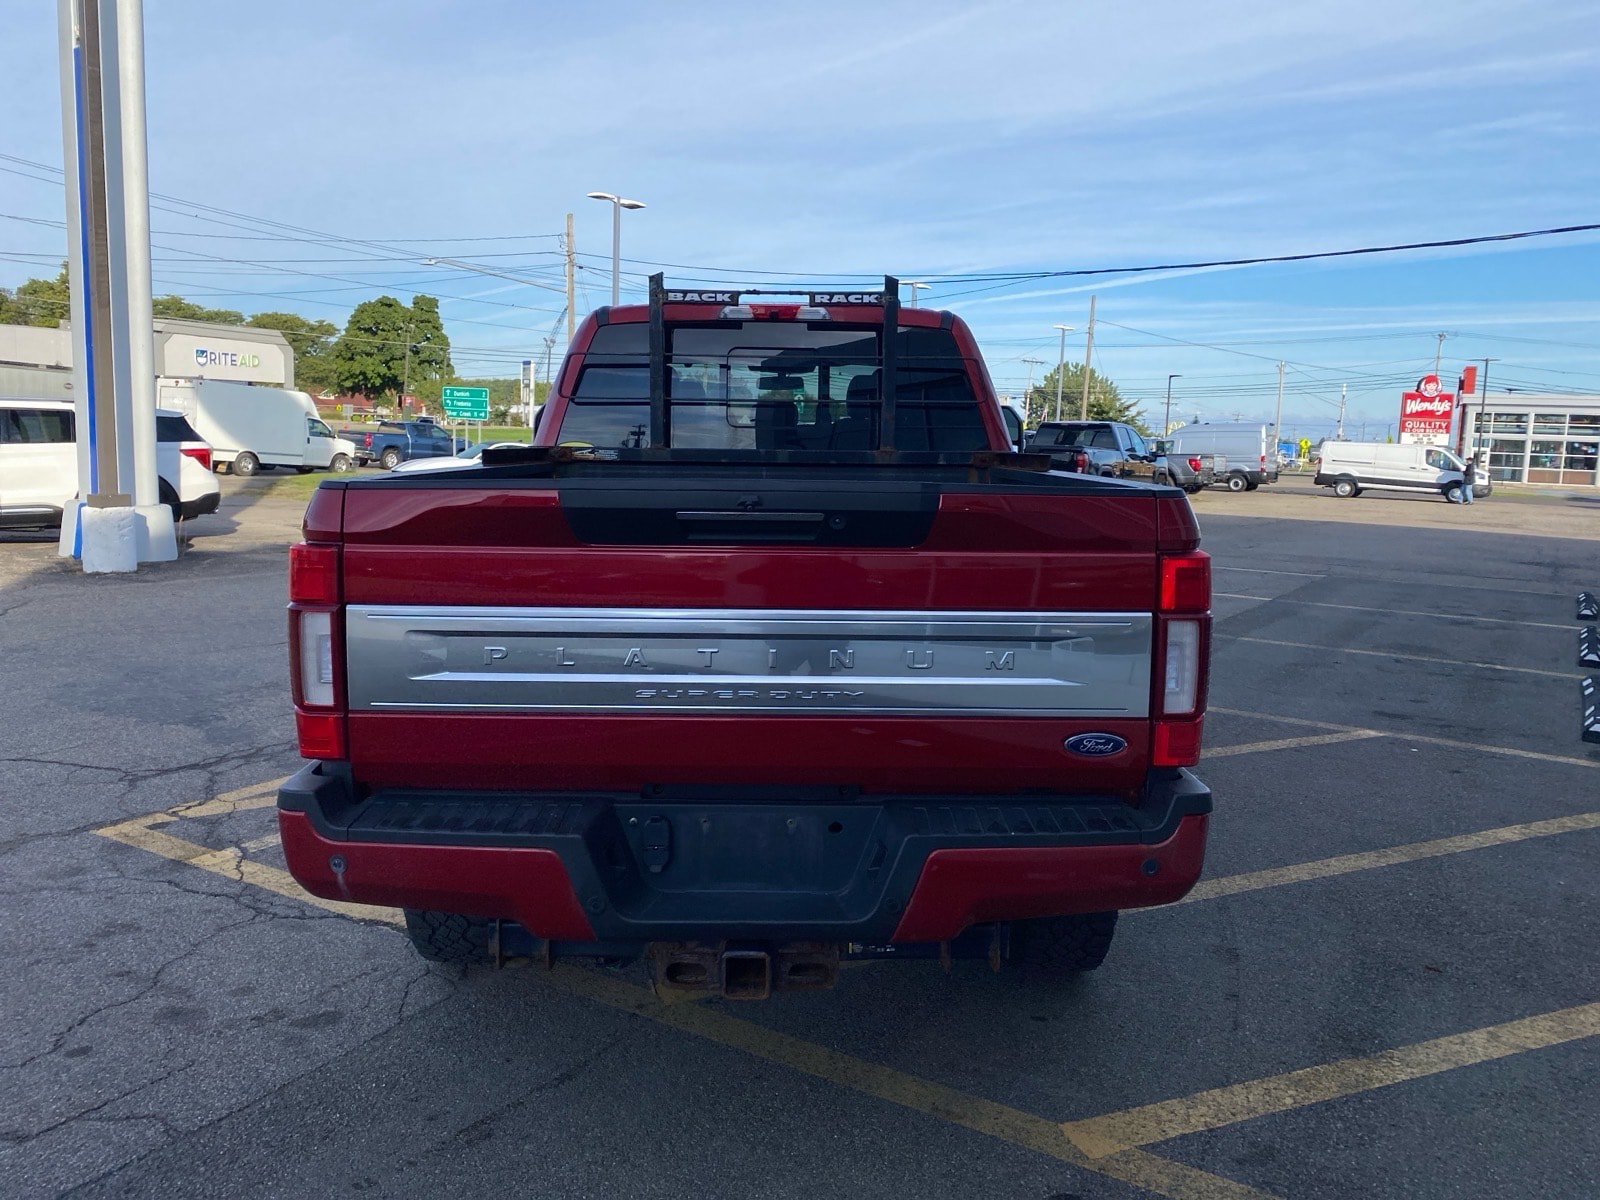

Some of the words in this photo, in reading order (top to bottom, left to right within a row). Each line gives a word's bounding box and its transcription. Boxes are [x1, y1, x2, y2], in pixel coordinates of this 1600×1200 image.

[667, 292, 732, 302] BACK
[814, 294, 880, 304] RACK
[209, 350, 237, 367] RITE
[238, 353, 260, 368] AID
[1405, 396, 1452, 415] Wendy's
[1405, 421, 1448, 429] QUALITY
[484, 646, 1015, 670] PLATINUM
[635, 689, 760, 699] SUPER
[769, 690, 865, 699] DUTY
[1079, 738, 1114, 752] Ford
